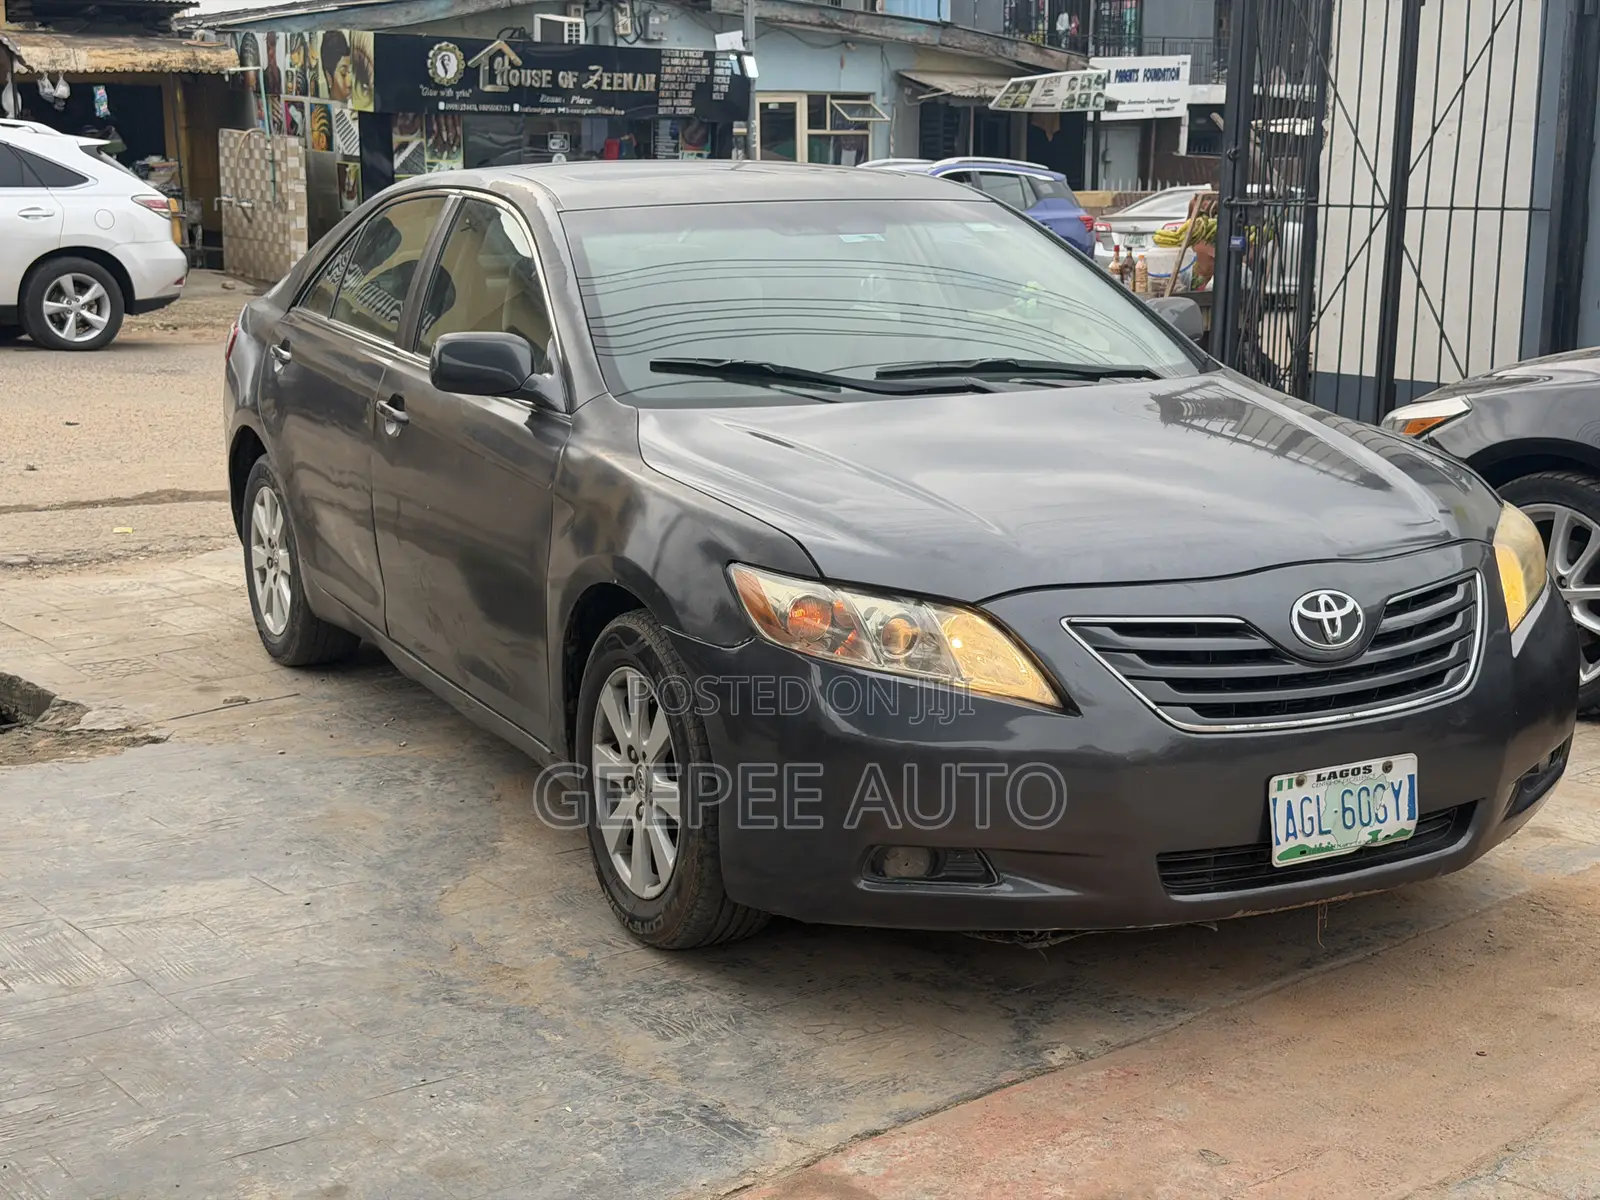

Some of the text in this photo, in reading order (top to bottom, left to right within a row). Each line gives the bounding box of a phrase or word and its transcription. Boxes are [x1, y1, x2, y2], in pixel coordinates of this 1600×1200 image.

[558, 70, 579, 89] OF
[1316, 764, 1373, 783] LAGOS
[1285, 795, 1332, 842] AGL
